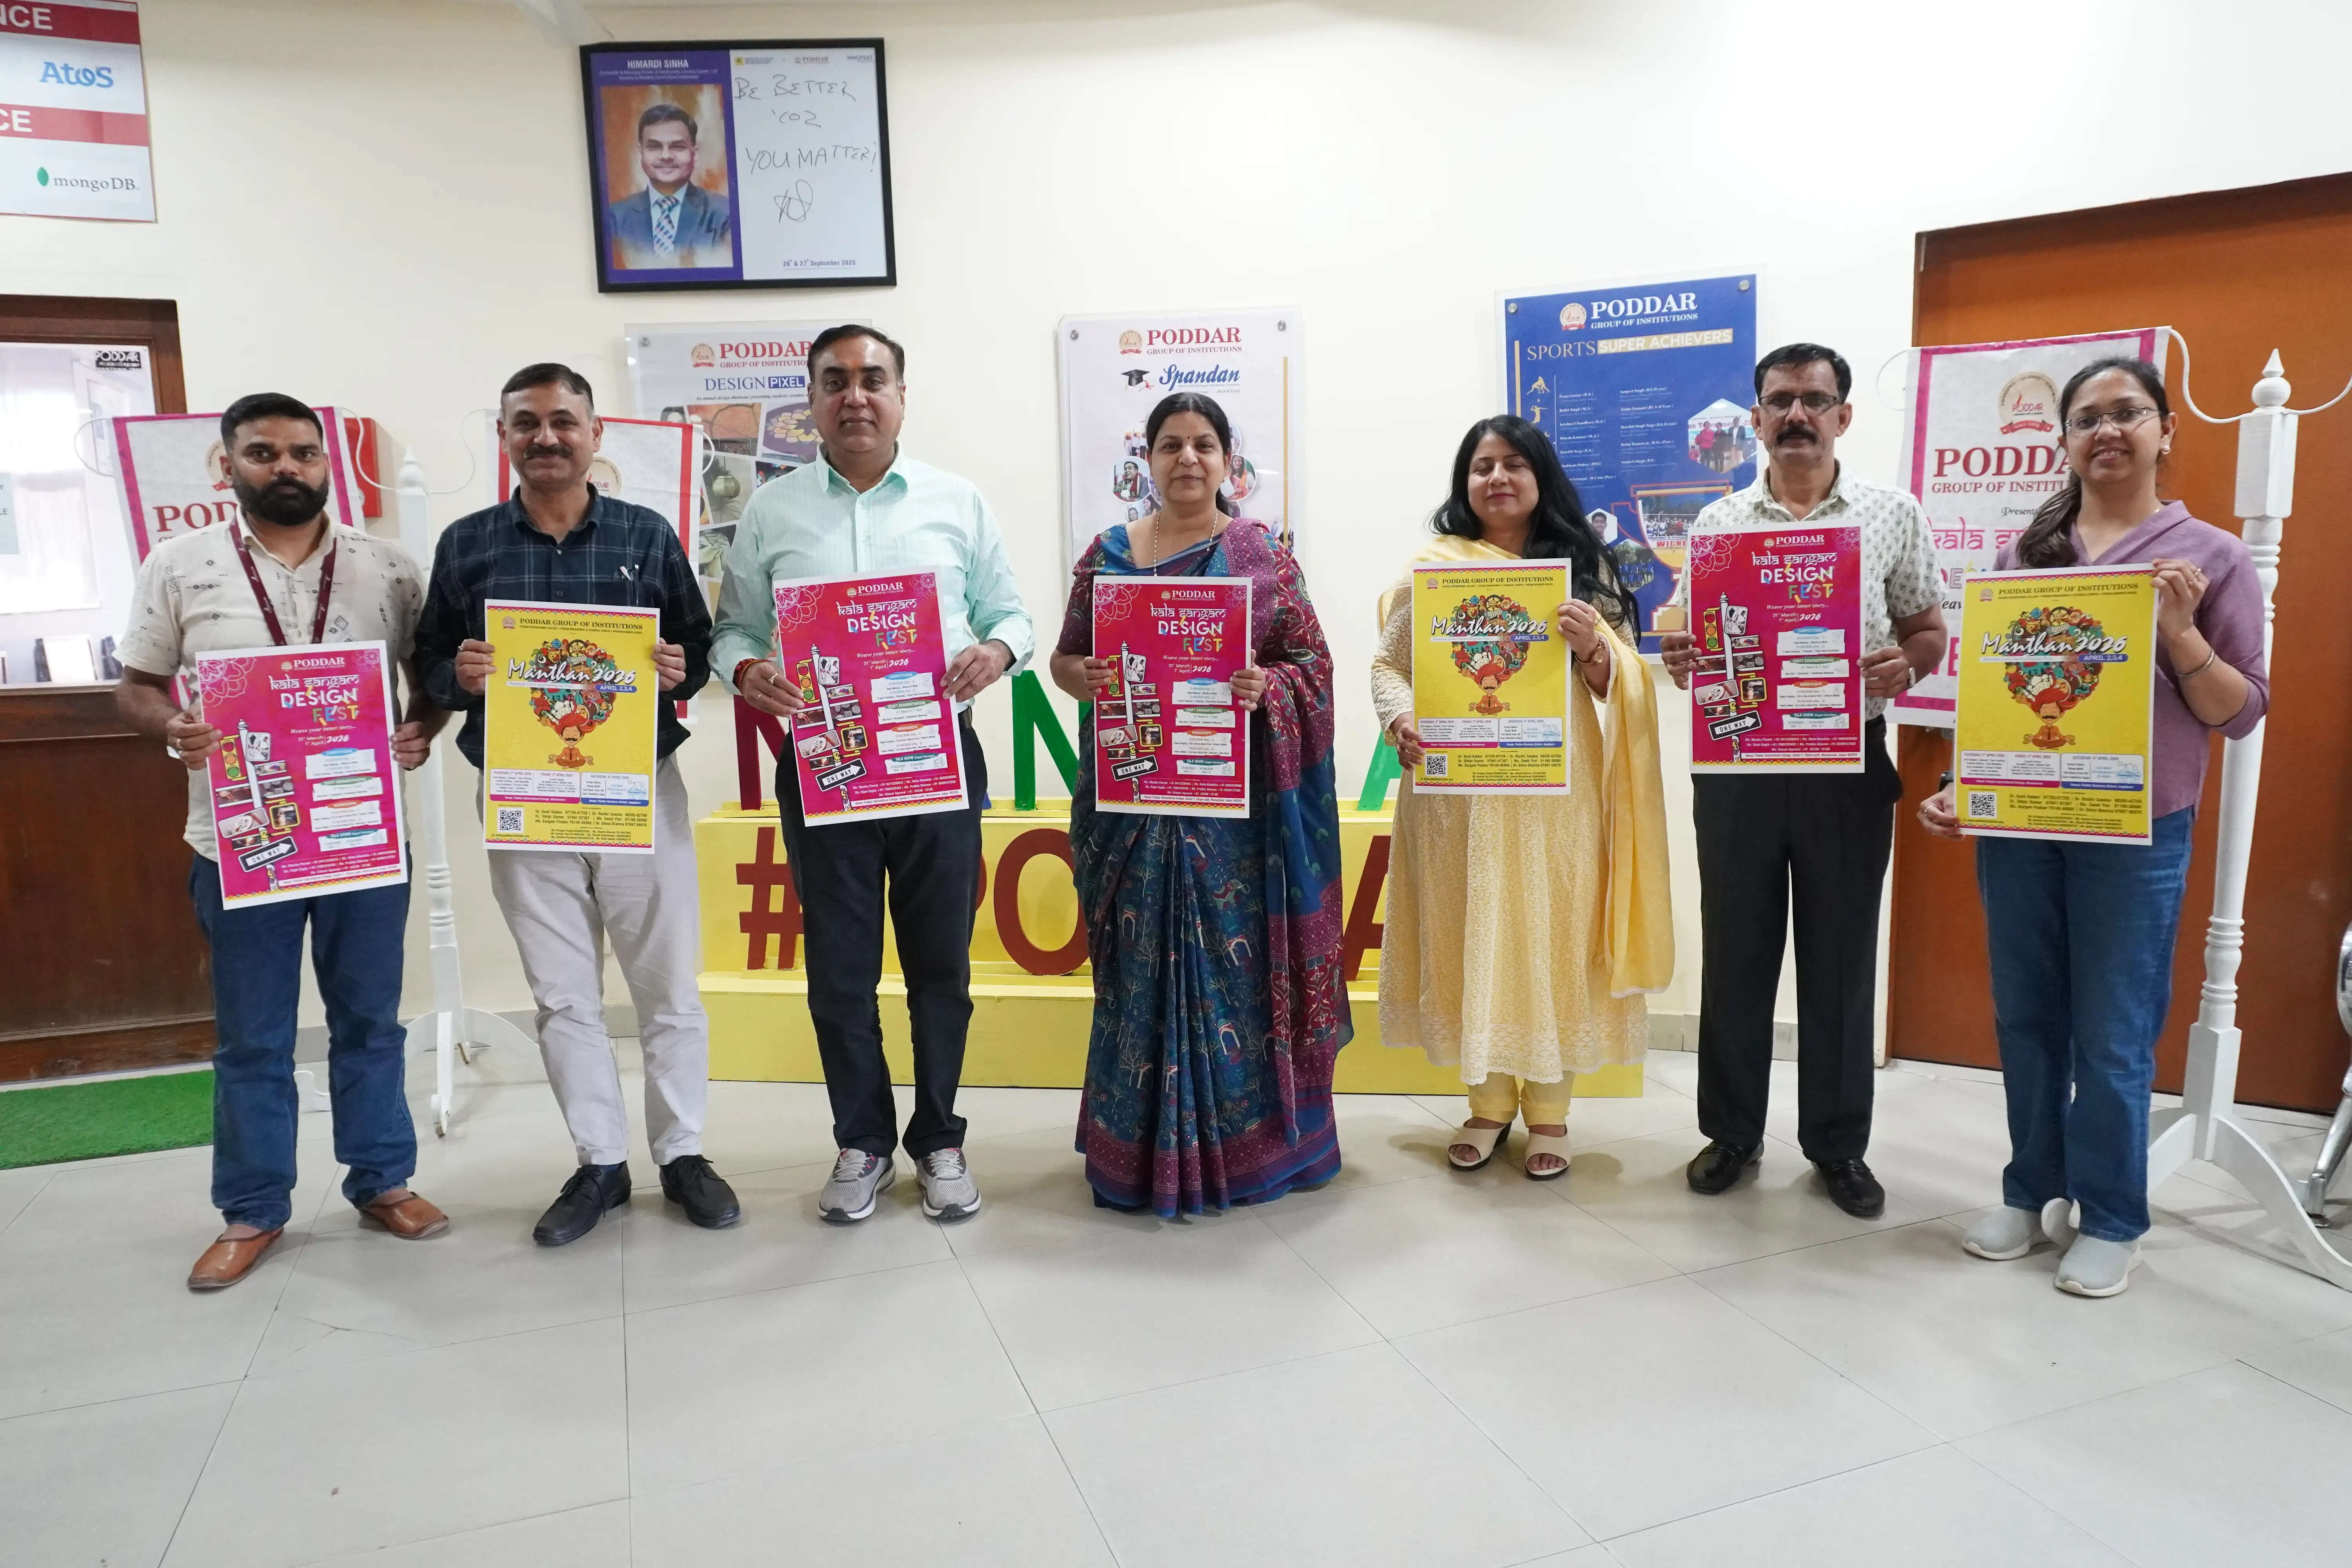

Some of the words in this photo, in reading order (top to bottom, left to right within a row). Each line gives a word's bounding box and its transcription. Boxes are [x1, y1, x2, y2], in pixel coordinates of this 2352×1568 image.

[627, 60, 661, 69] HIMARDI
[664, 59, 688, 68] SINHA
[40, 62, 113, 88] Atos
[734, 78, 761, 100] BE
[773, 74, 855, 101] BETTER
[746, 147, 790, 174] YOU
[1590, 292, 1698, 319] PODDAR
[1591, 320, 1621, 329] GROUP
[1637, 313, 1698, 325] INSTITUTIONS
[1147, 327, 1241, 345] PODDAR
[1528, 341, 1596, 360] SPORTS
[1599, 338, 1645, 352] SUPER
[1650, 330, 1732, 348] ACHIEVERS
[94, 351, 140, 362] PODDAR
[705, 377, 766, 390] DESIGN
[770, 377, 803, 388] PIXEL
[1159, 364, 1241, 391] Spandan
[2013, 398, 2043, 412] PODDAR
[1932, 482, 1982, 493] GROUP
[1986, 482, 2006, 492] OF
[1776, 535, 1825, 544] PODDAR
[1751, 550, 1780, 566] kala
[1784, 552, 1837, 567] sangam
[1761, 566, 1834, 583] DESIGN
[858, 582, 903, 593] PODDAR
[1789, 583, 1833, 599] FEST
[2078, 583, 2139, 591] INSTITUTIONS
[836, 600, 863, 615] kala
[867, 599, 916, 614] sangam
[1150, 603, 1175, 617] kala
[1179, 609, 1226, 621] sangam
[847, 612, 915, 633] DESIGN
[1799, 613, 1821, 621] 2026
[1158, 621, 1223, 635] DESIGN
[1432, 615, 1506, 637] Manthan
[1508, 618, 1548, 634] 2026
[876, 629, 916, 646] FEST
[1183, 638, 1222, 652] FEST
[1982, 631, 2073, 656] Manthan
[2076, 635, 2128, 653] 2026
[293, 657, 345, 668] PODDAR
[888, 658, 909, 667] 2026
[508, 657, 591, 683] Manthan
[592, 666, 636, 685] 2026
[268, 674, 299, 690] kala
[303, 675, 359, 690] sangam
[281, 688, 358, 708] DESIGN
[312, 705, 359, 722] FEST
[1719, 724, 1732, 733] ONE
[1733, 719, 1746, 729] WAY
[327, 735, 349, 743] 2026
[1133, 763, 1145, 772] WAY
[826, 775, 839, 784] ONE
[840, 769, 852, 780] WAY
[251, 853, 265, 864] ONE
[266, 848, 282, 860] WAY
